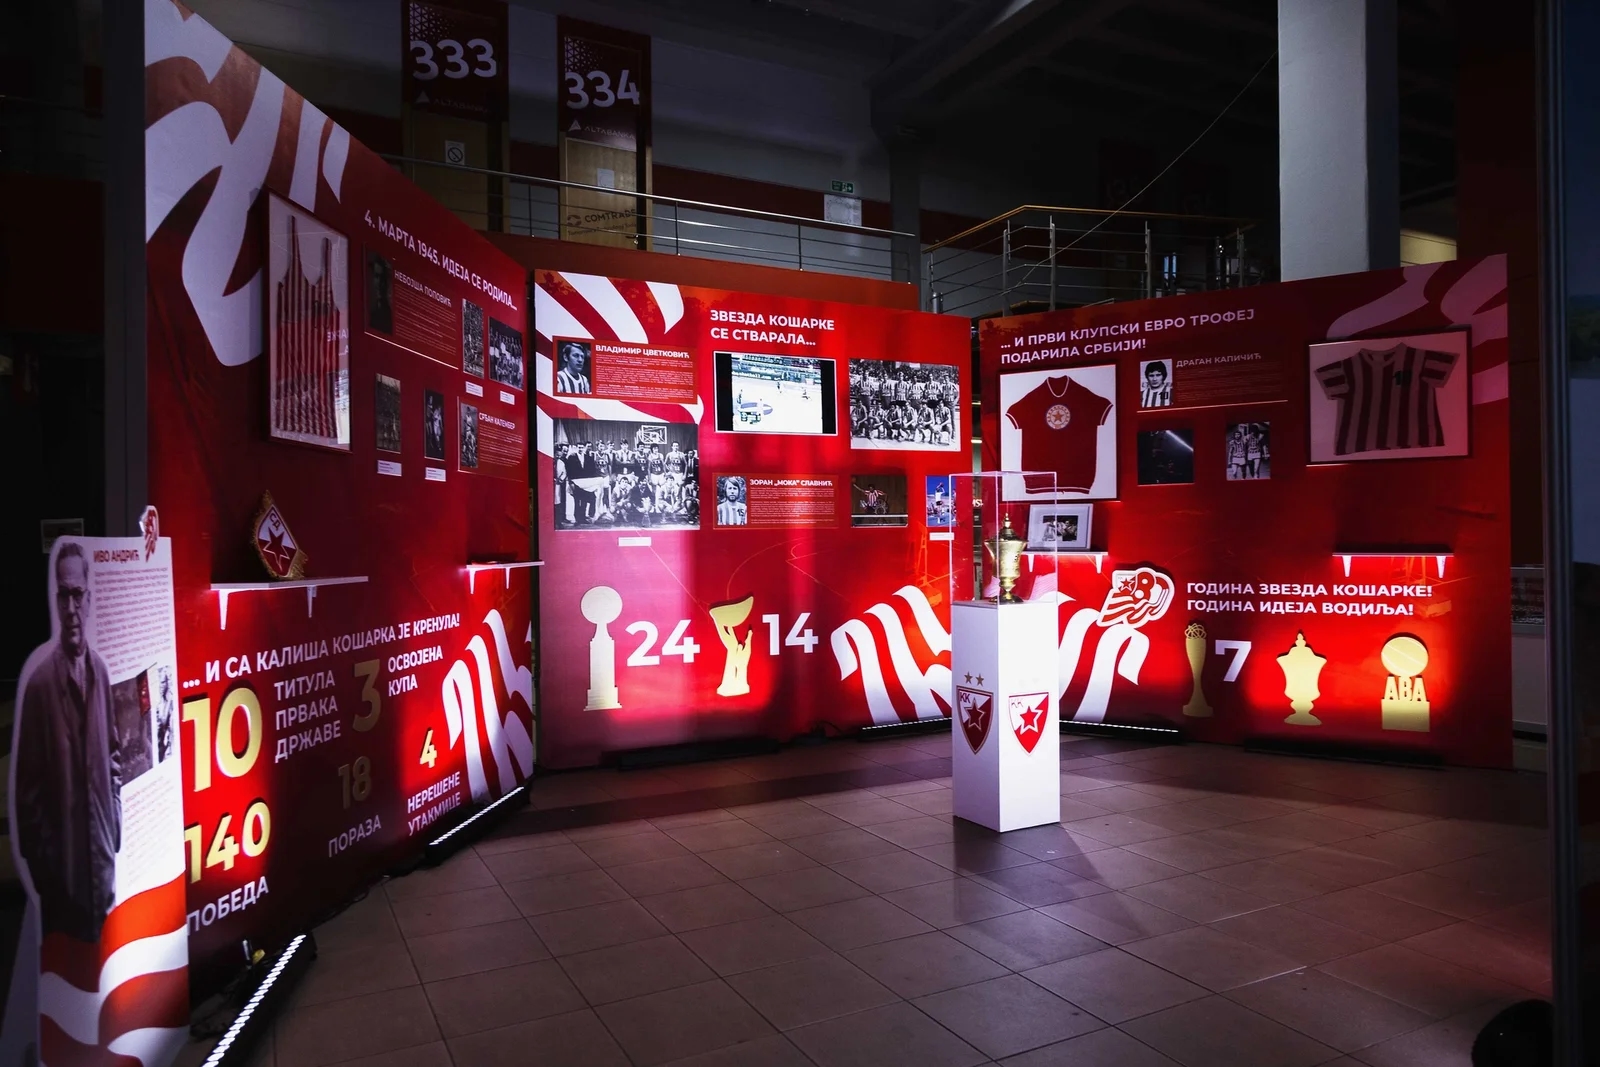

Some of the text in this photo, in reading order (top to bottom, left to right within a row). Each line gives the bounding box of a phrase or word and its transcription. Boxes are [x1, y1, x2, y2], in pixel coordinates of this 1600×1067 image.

[409, 38, 498, 81] 333
[564, 69, 641, 110] 334
[584, 125, 636, 141] ALTABANKA
[364, 209, 376, 229] 4.
[378, 216, 416, 252] МАРТА
[417, 239, 441, 267] 1945.
[442, 254, 471, 285] ИДЕЈА
[471, 272, 482, 290] СЕ
[394, 269, 452, 308] НЕБОЈША ПОПОВИЋ
[710, 309, 835, 331] ЗВЕЗДА КОШАРКЕ
[710, 327, 816, 347] СЕ СТВАРАЛА...
[1014, 335, 1024, 347] И
[1027, 331, 1067, 346] ПРВИ
[1070, 322, 1140, 341] КЛУПСКИ
[1144, 317, 1186, 332] ЕВРО
[1189, 308, 1255, 327] ТРОФЕЈ
[595, 344, 690, 359] ВЛАДИМИР ЦВЕТКОВИЋ
[1001, 338, 1147, 365] ПОДАРИЛА СРБИЈИ!
[1175, 351, 1262, 369] ДРАГАН КАПИЧИЋ
[749, 479, 773, 487] ЗОРАН
[93, 549, 140, 564] ИВО АНДРИЋ
[1186, 582, 1433, 598] ГОДИНА ЗВЕЗДА КОШАРКЕ!
[1186, 600, 1414, 617] ГОДИНА ИДЕЈА ВОДИЉА!
[205, 660, 221, 684] И
[224, 655, 252, 679] СА
[256, 639, 329, 673] КАЛИША
[332, 625, 396, 655] КОШАРКА
[397, 622, 411, 641] ЈЕ
[412, 613, 461, 638] КРЕНУЛА!
[625, 619, 701, 667] 24
[762, 612, 819, 656] 14
[387, 644, 444, 674] ОСВОЈЕНА
[1214, 639, 1252, 683] 7
[274, 669, 336, 702] ТИТУЛА
[352, 658, 382, 732] 3
[388, 673, 418, 697] КУПА
[275, 695, 338, 731] ПРВАКА
[182, 686, 263, 793] 10
[275, 719, 342, 763] ДРЖАВЕ
[419, 729, 438, 769] 4
[338, 755, 371, 810] 18
[407, 771, 462, 814] НЕРЕШЕНЕ
[408, 793, 462, 836] УТАКМИЦЕ
[184, 801, 271, 884] 140
[328, 814, 382, 858] ПОРАЗА
[186, 875, 269, 936] ПОБЕДА
